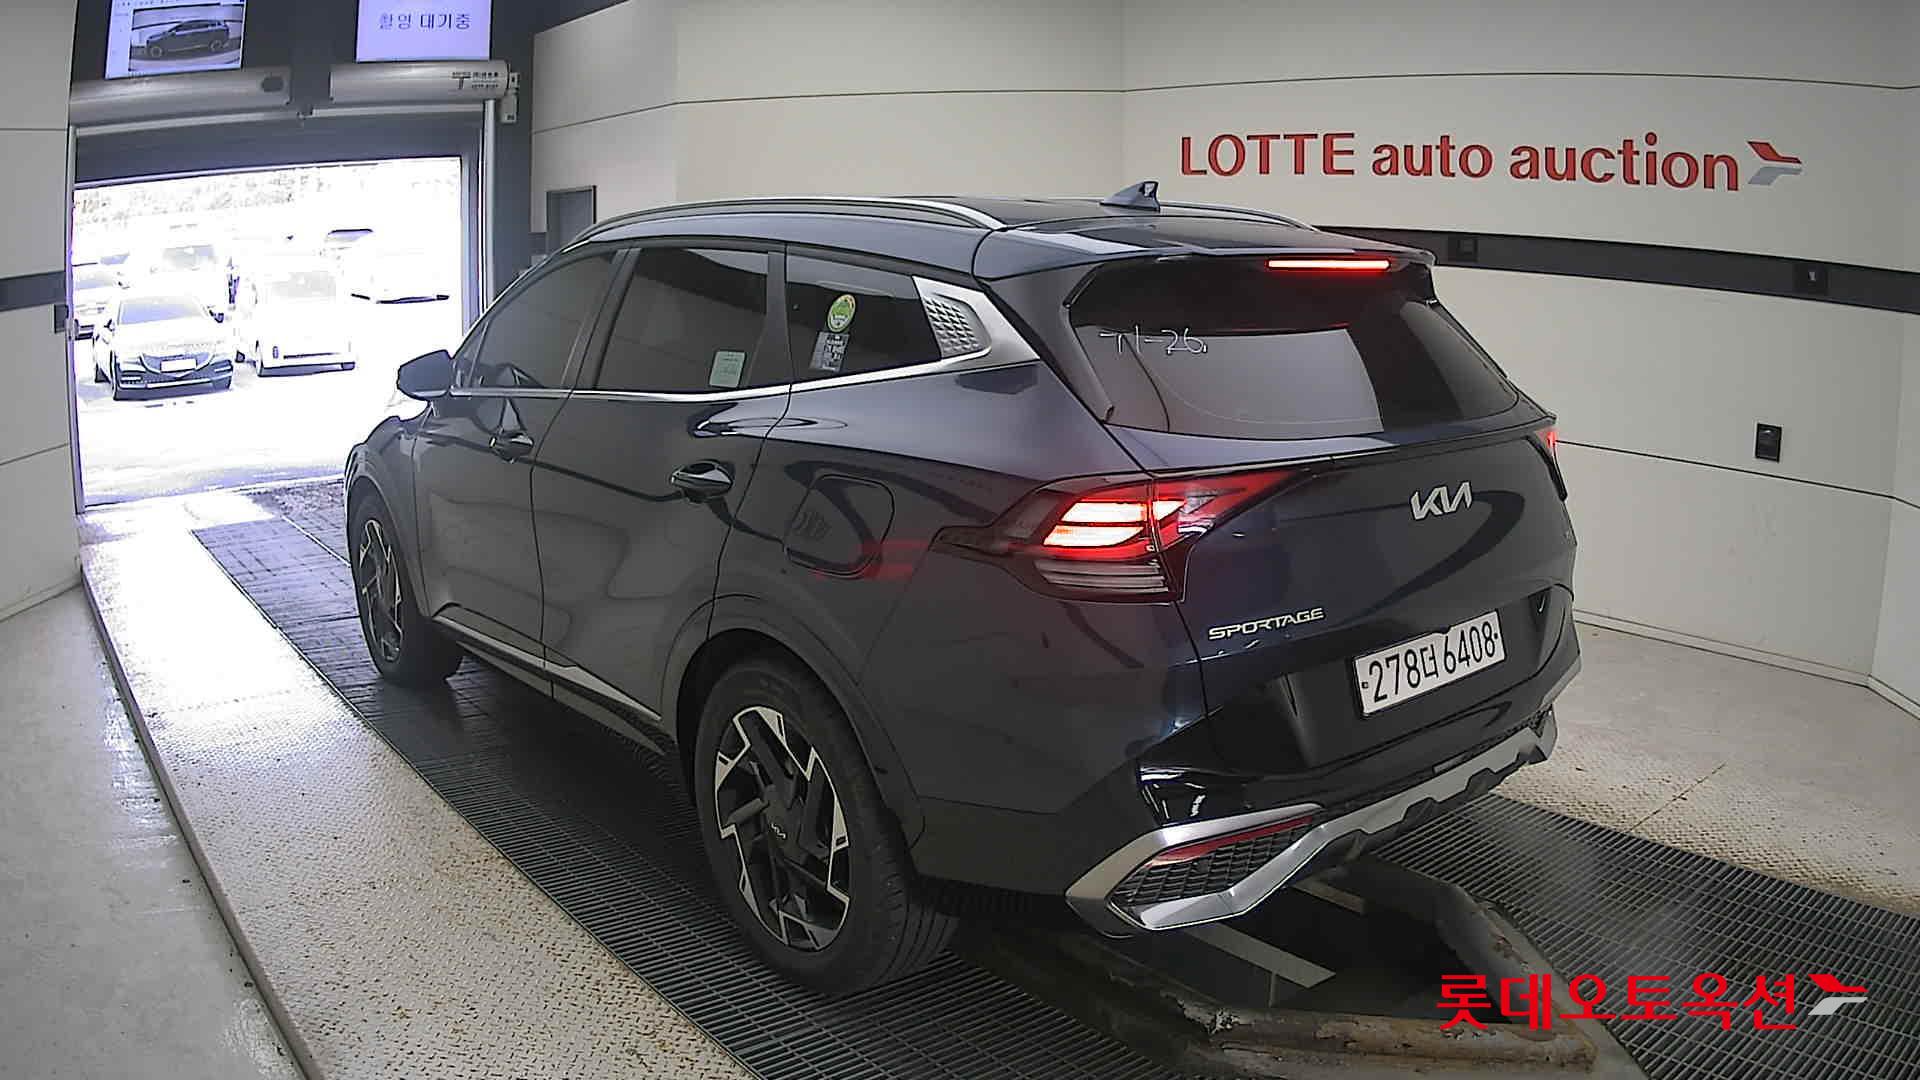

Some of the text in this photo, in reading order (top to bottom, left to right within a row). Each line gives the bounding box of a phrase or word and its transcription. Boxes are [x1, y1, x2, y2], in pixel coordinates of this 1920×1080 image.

[420, 13, 471, 30] 대기중
[1181, 132, 1740, 191] LOTTE auto auction
[1208, 607, 1325, 640] SPORTAGE
